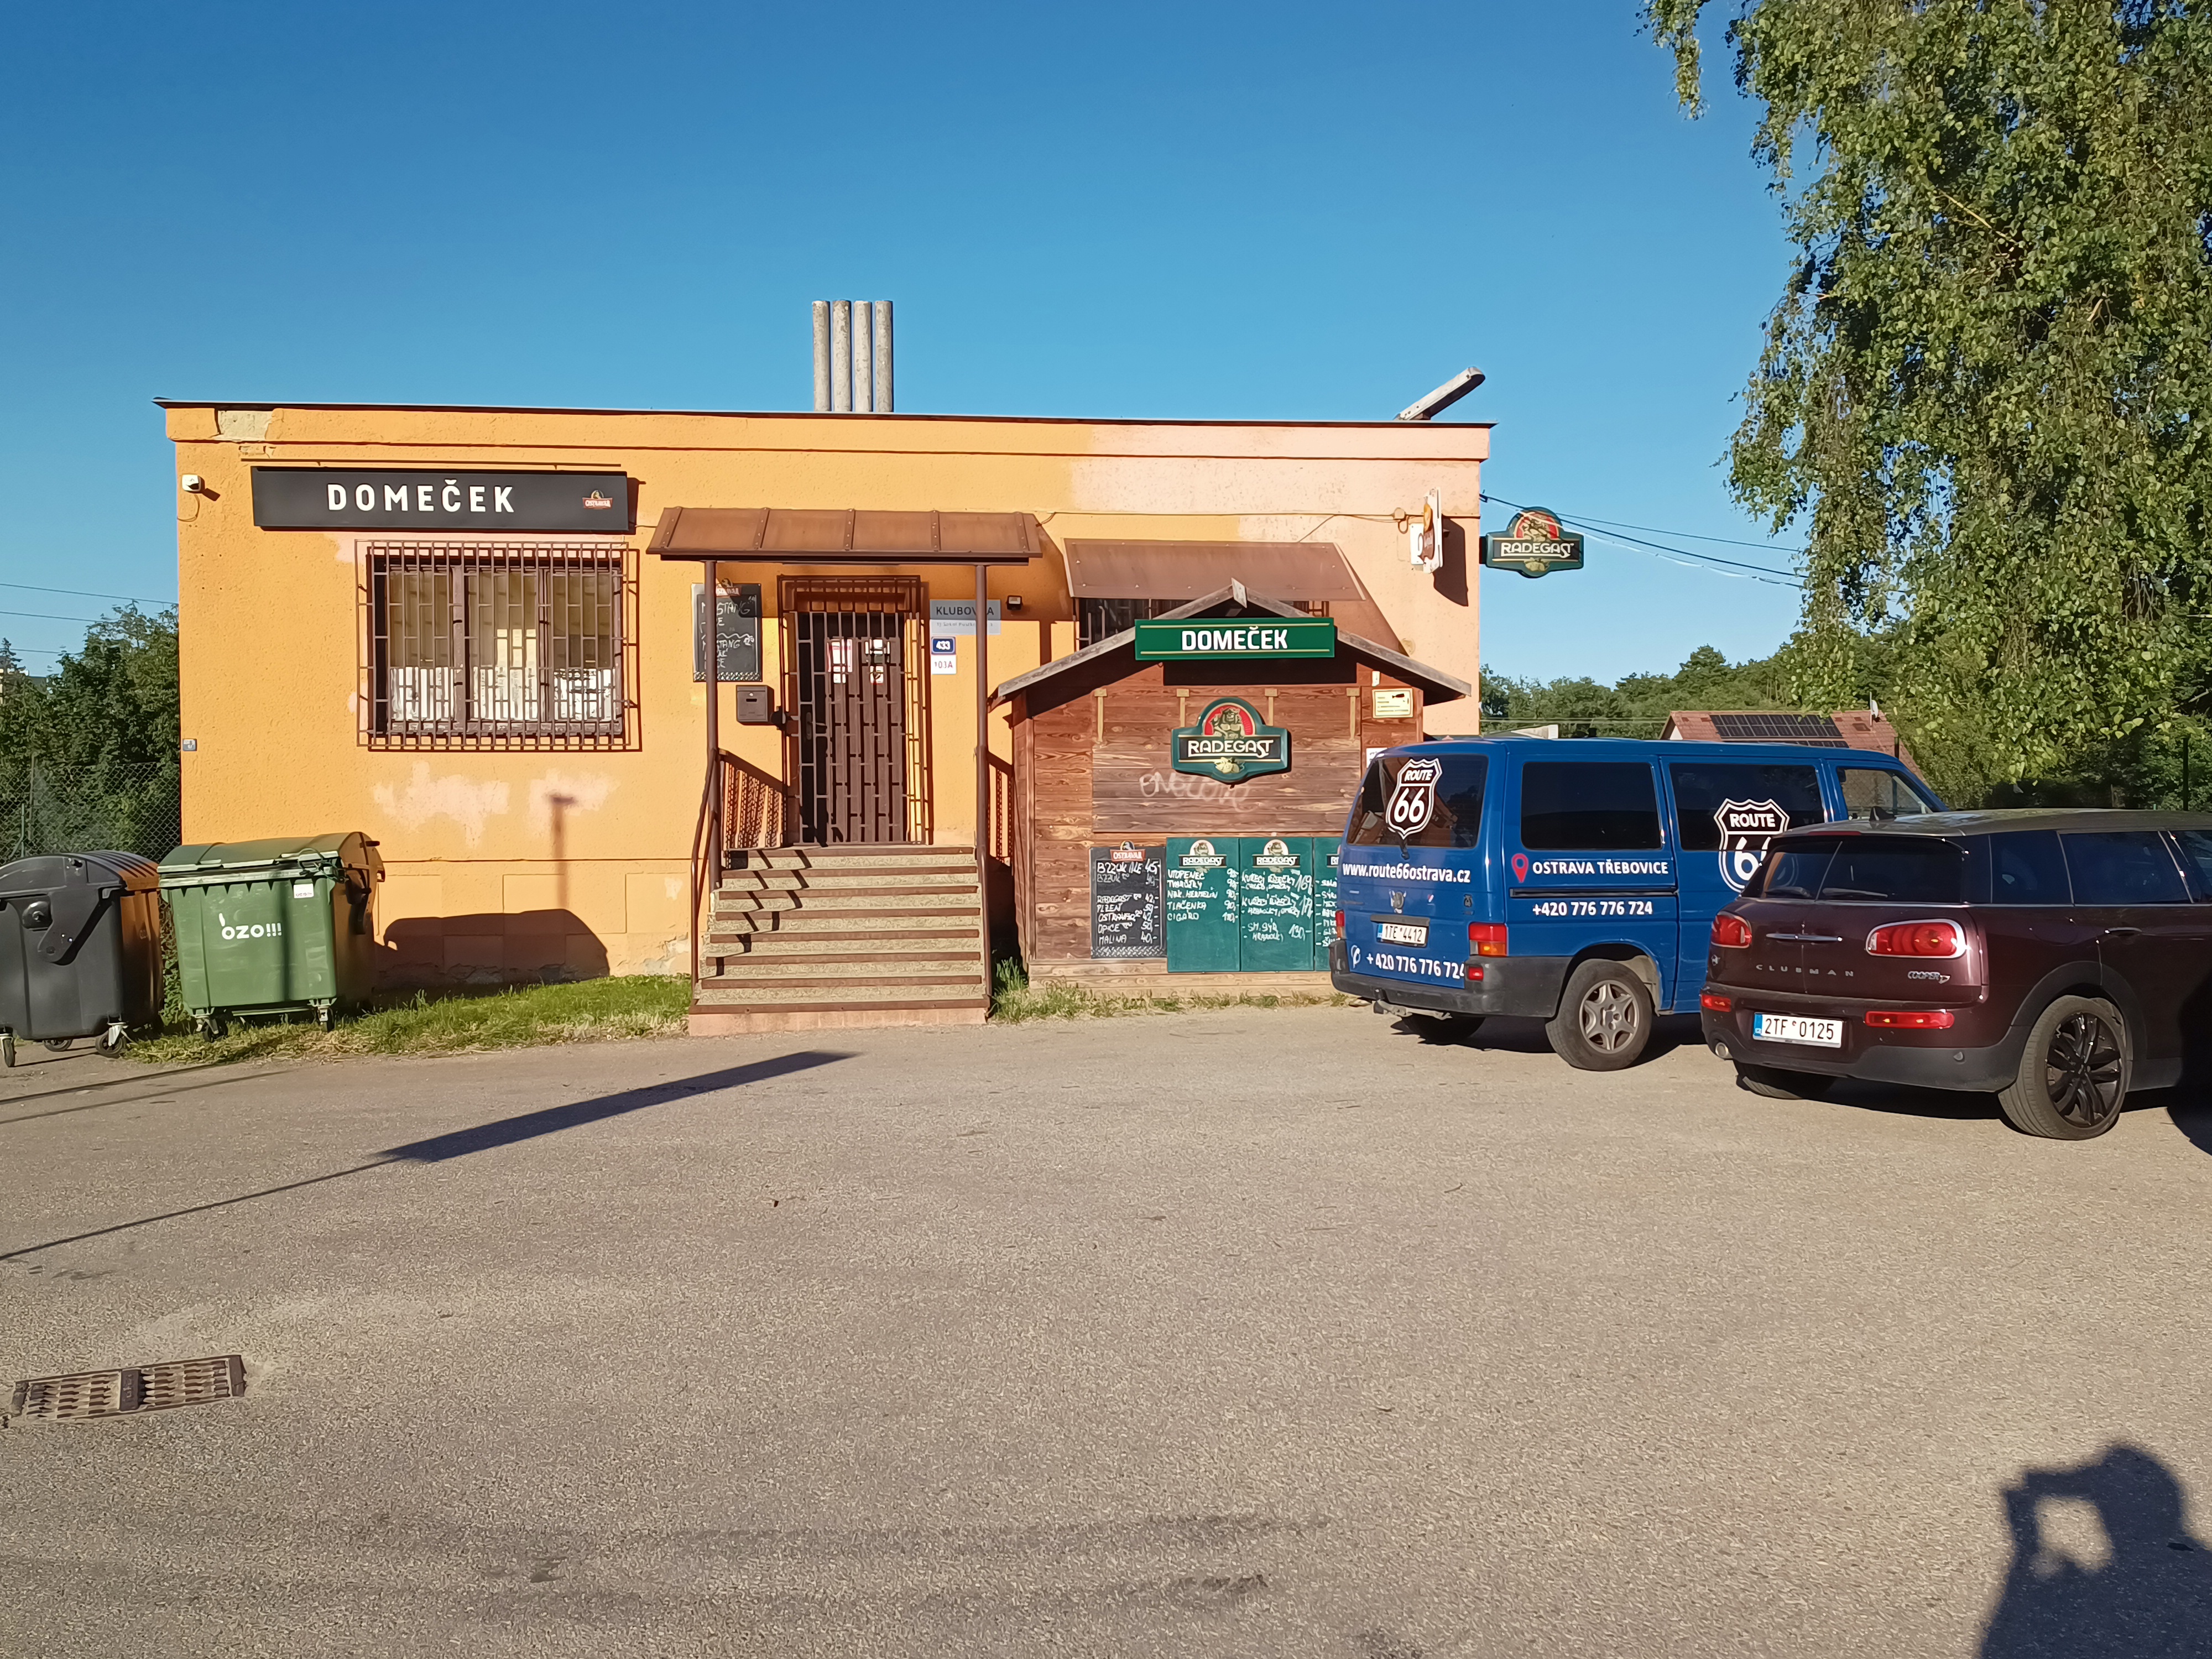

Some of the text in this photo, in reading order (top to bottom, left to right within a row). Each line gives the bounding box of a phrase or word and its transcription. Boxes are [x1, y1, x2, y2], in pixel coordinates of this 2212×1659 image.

[328, 479, 514, 513] DOMEČEK
[1501, 541, 1574, 559] RADEGAST
[936, 606, 994, 615] KLUBOVA
[1182, 625, 1288, 651] DOMEČEK
[1188, 739, 1274, 758] RADEGAST
[1404, 769, 1434, 781] ROUTE
[1394, 787, 1425, 823] 66
[1729, 813, 1776, 828] ROUTE
[1182, 857, 1224, 866] RADEGAST
[1256, 857, 1298, 866] RADEGAST
[1532, 859, 1669, 874] OSTRAVA TŘEBOVICE
[1342, 863, 1471, 883] www.route66ostrava.cz
[1532, 901, 1653, 916] +420 776 776 724
[1385, 925, 1423, 942] 1TE 4412
[1396, 956, 1417, 973] 776
[1419, 958, 1442, 977] 776
[1755, 964, 1854, 977] CLUBMAN
[1765, 1018, 1835, 1041] 2TF 0125
